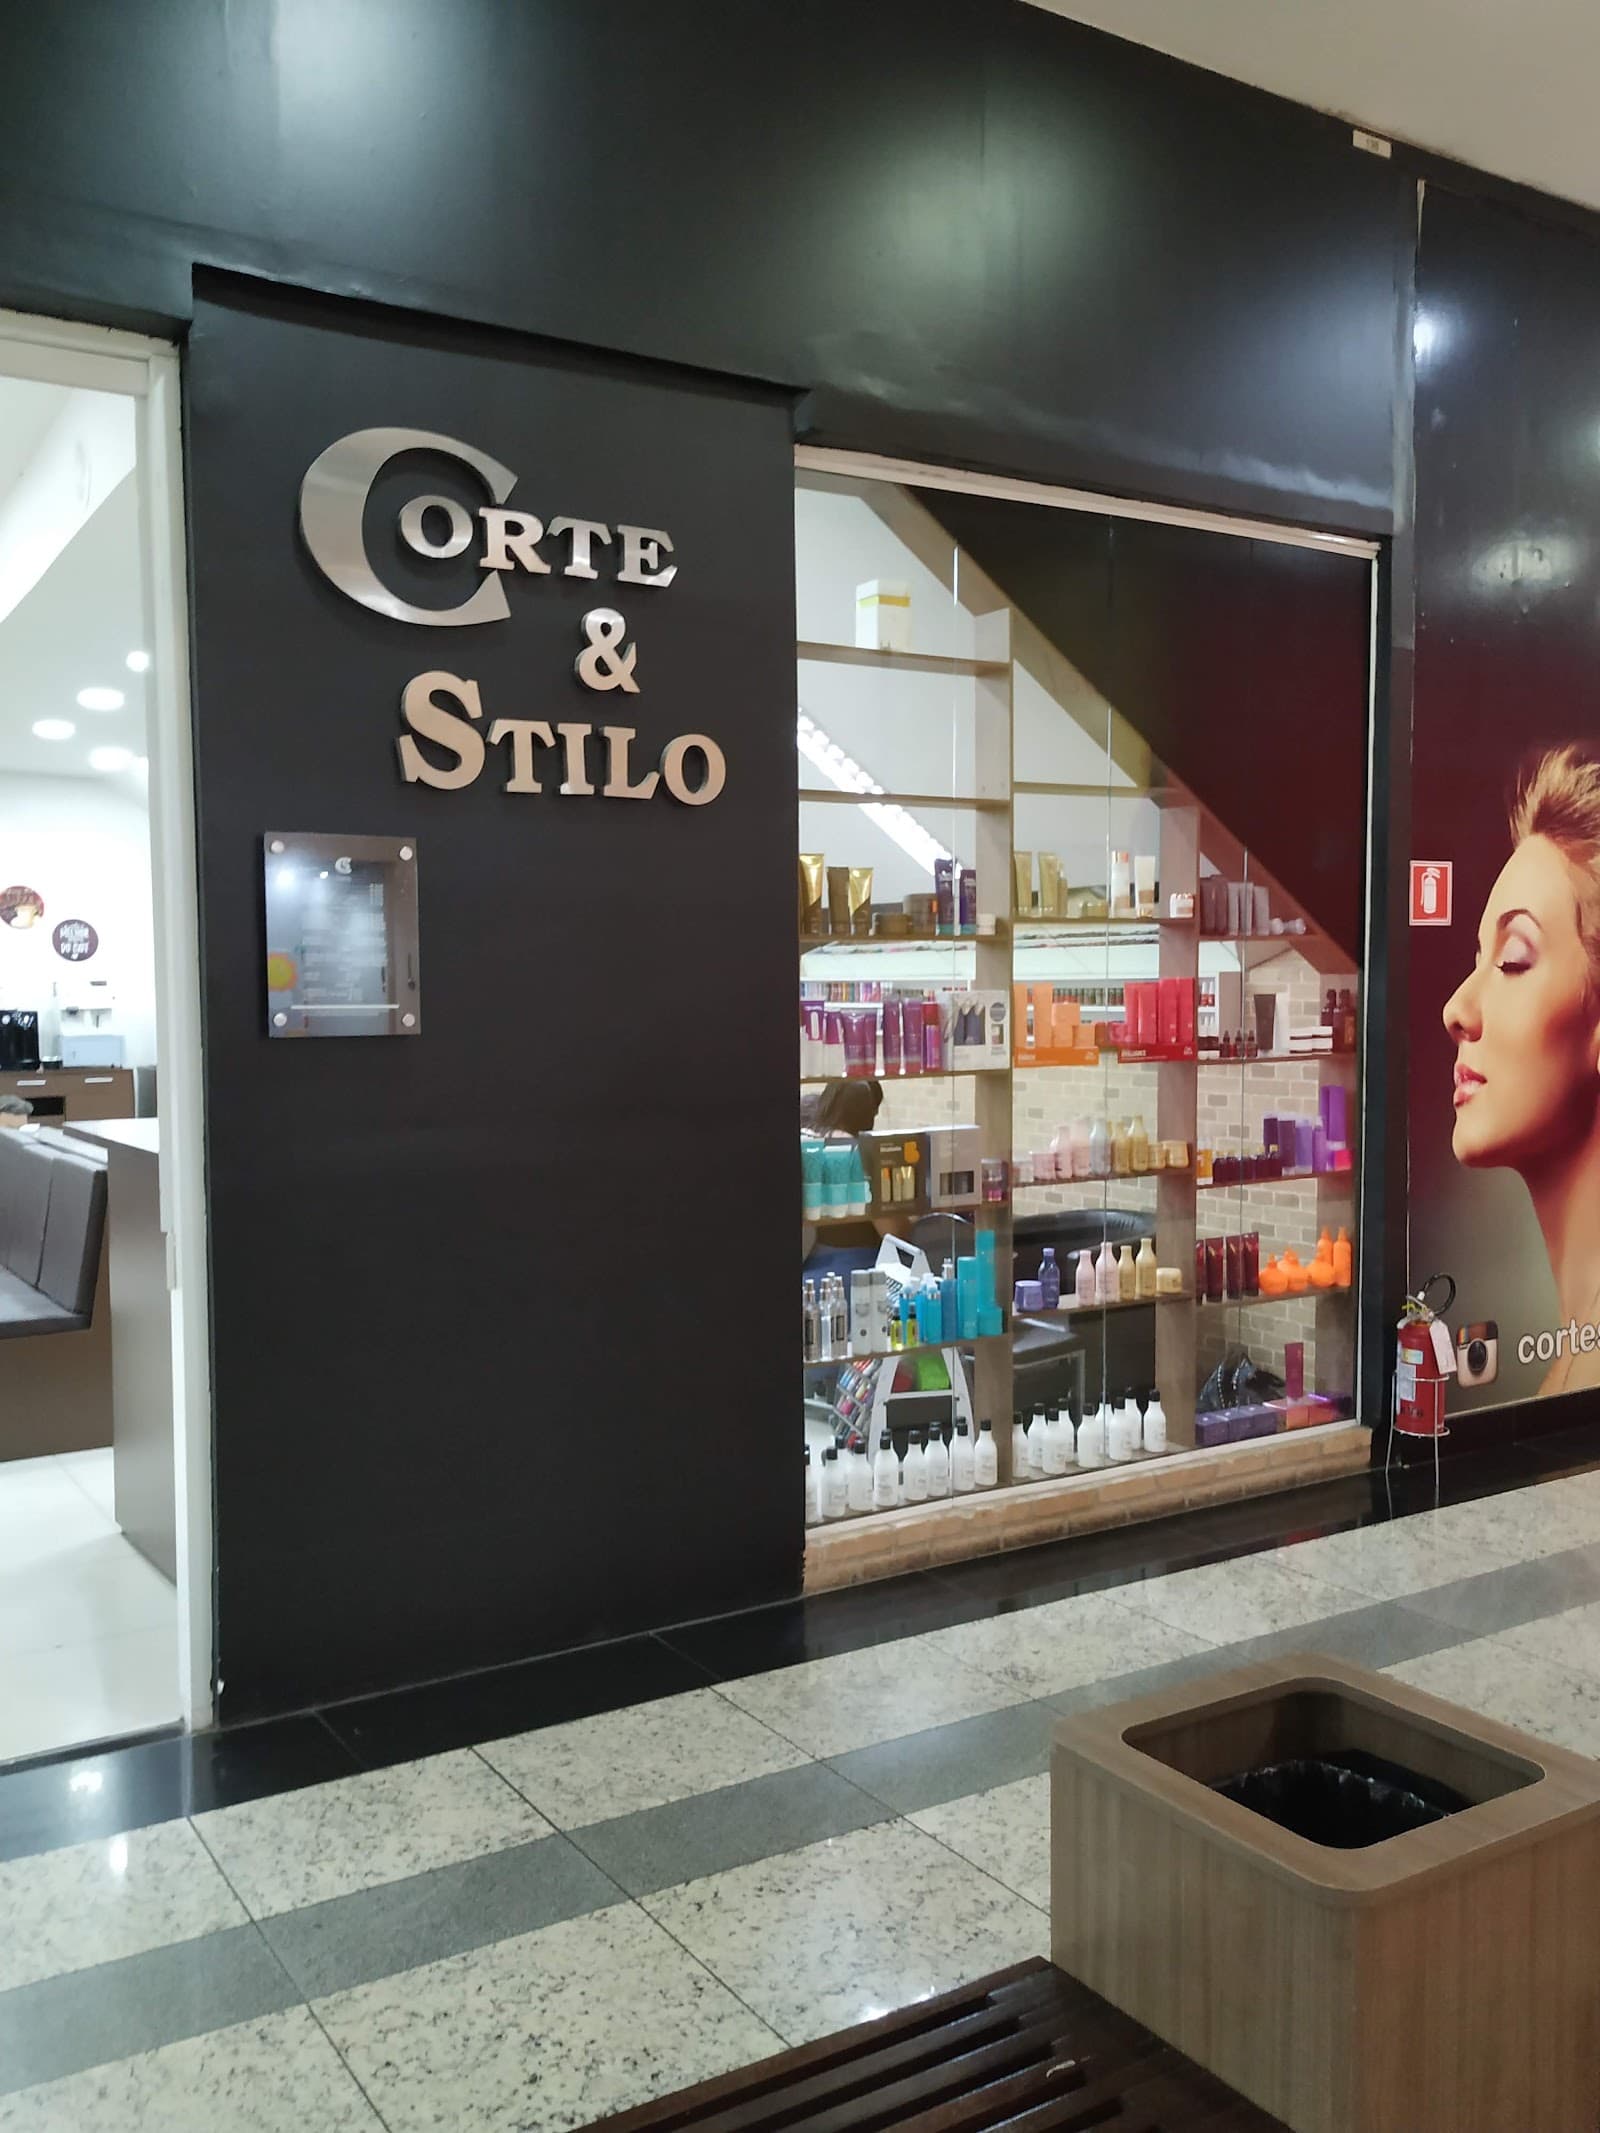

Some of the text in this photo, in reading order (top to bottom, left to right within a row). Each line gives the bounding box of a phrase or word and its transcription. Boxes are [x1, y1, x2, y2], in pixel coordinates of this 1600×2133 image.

[574, 607, 641, 694] &
[397, 670, 727, 806] STILO
[1517, 1318, 1600, 1365] corte
